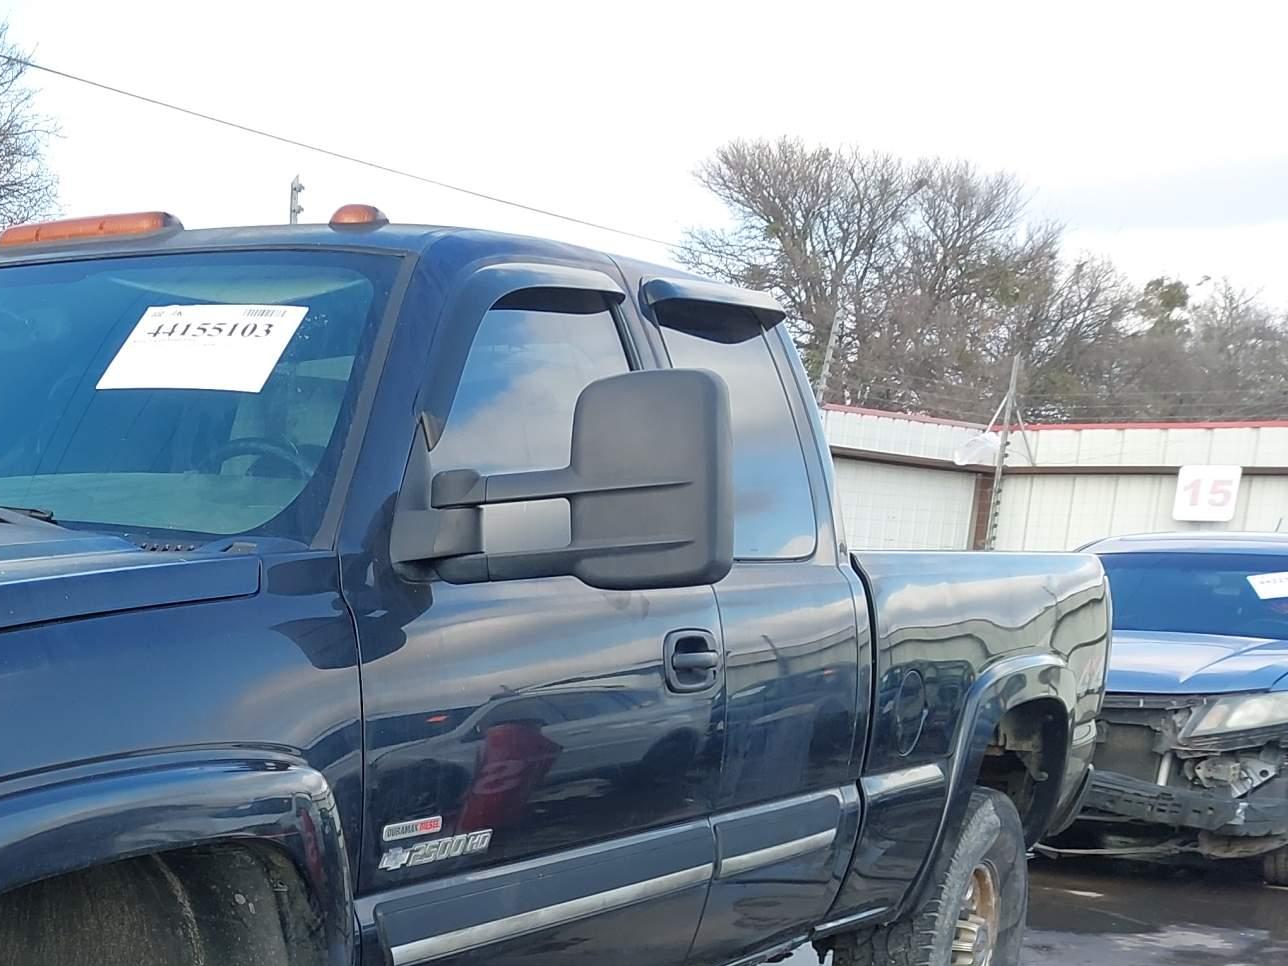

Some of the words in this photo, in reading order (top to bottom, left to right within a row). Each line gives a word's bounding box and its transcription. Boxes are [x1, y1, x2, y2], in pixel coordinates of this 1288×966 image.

[146, 322, 275, 338] 44155103
[1183, 478, 1234, 507] 15
[386, 823, 418, 838] DURAMAX
[418, 818, 441, 833] DIESEL
